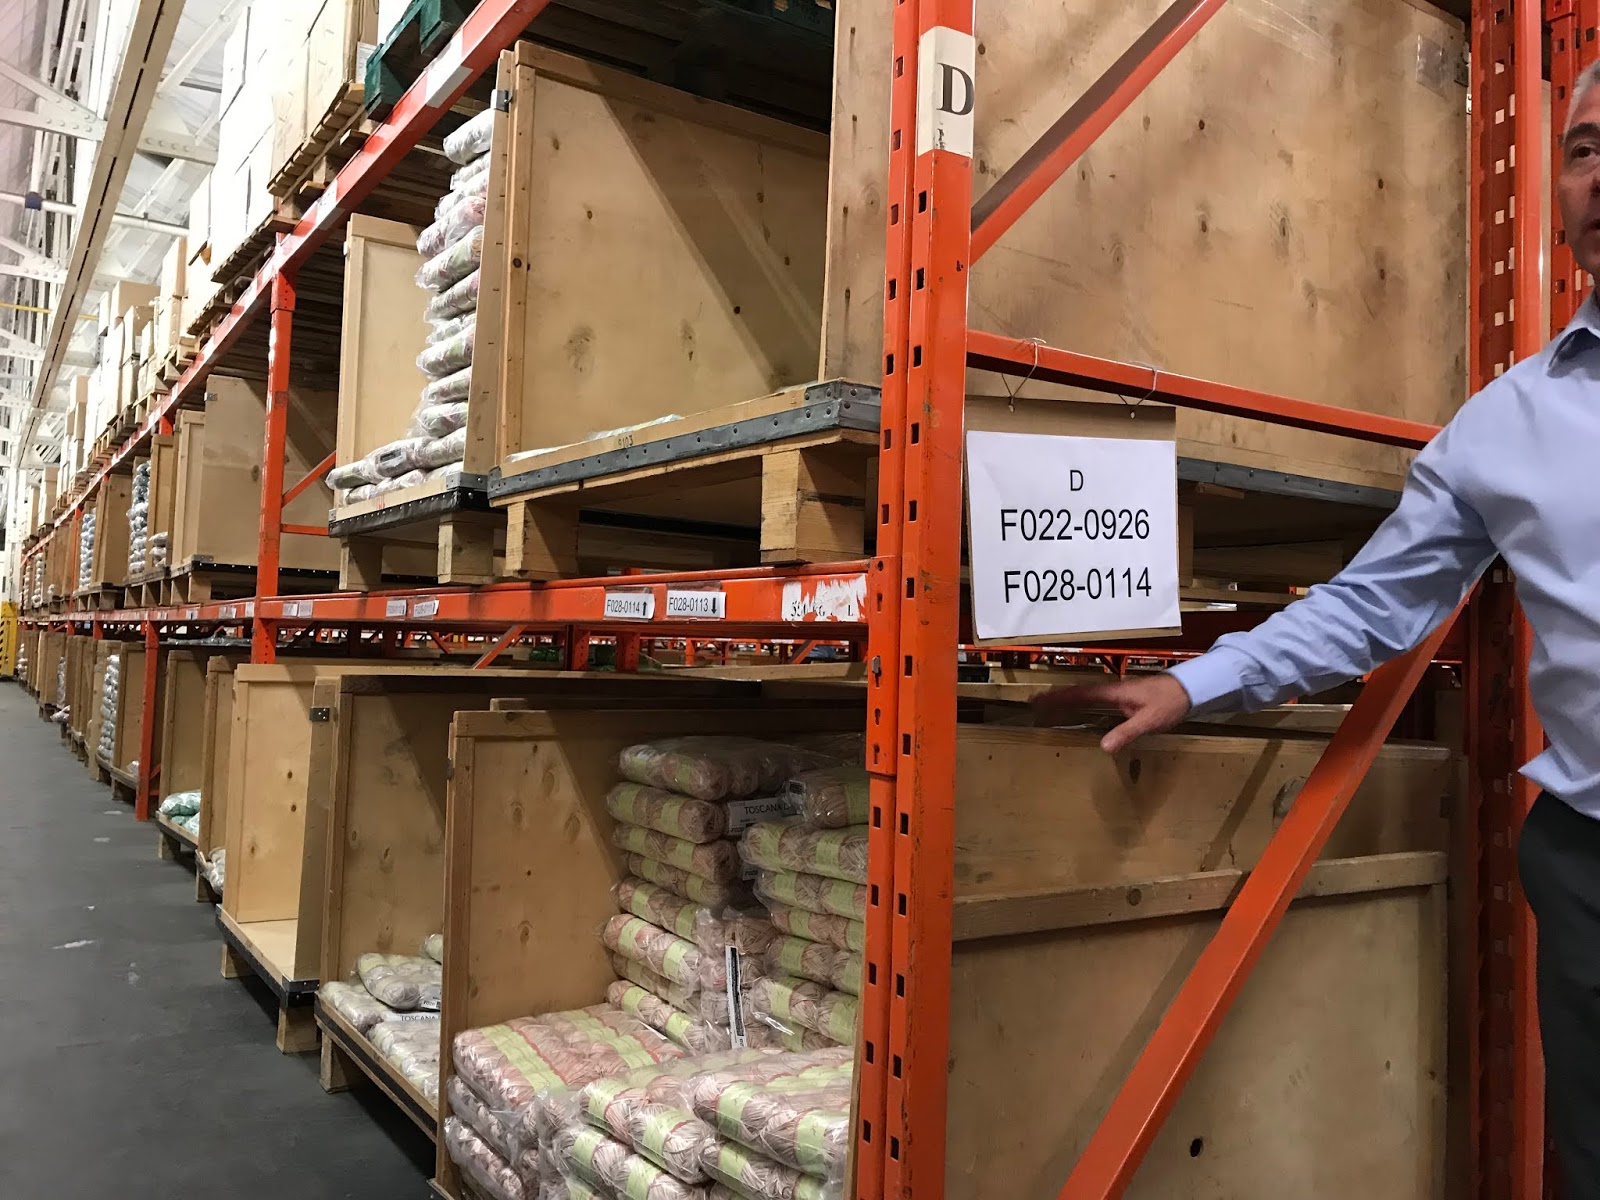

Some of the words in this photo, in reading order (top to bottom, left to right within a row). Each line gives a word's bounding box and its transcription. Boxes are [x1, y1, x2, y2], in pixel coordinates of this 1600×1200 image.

[936, 62, 975, 115] D
[1069, 469, 1084, 491] D
[1000, 508, 1150, 542] F022-0926
[1003, 566, 1152, 604] F028-0114
[606, 599, 640, 614] F028-0114
[668, 596, 709, 612] F028-0113
[744, 803, 782, 815] TOSCANA
